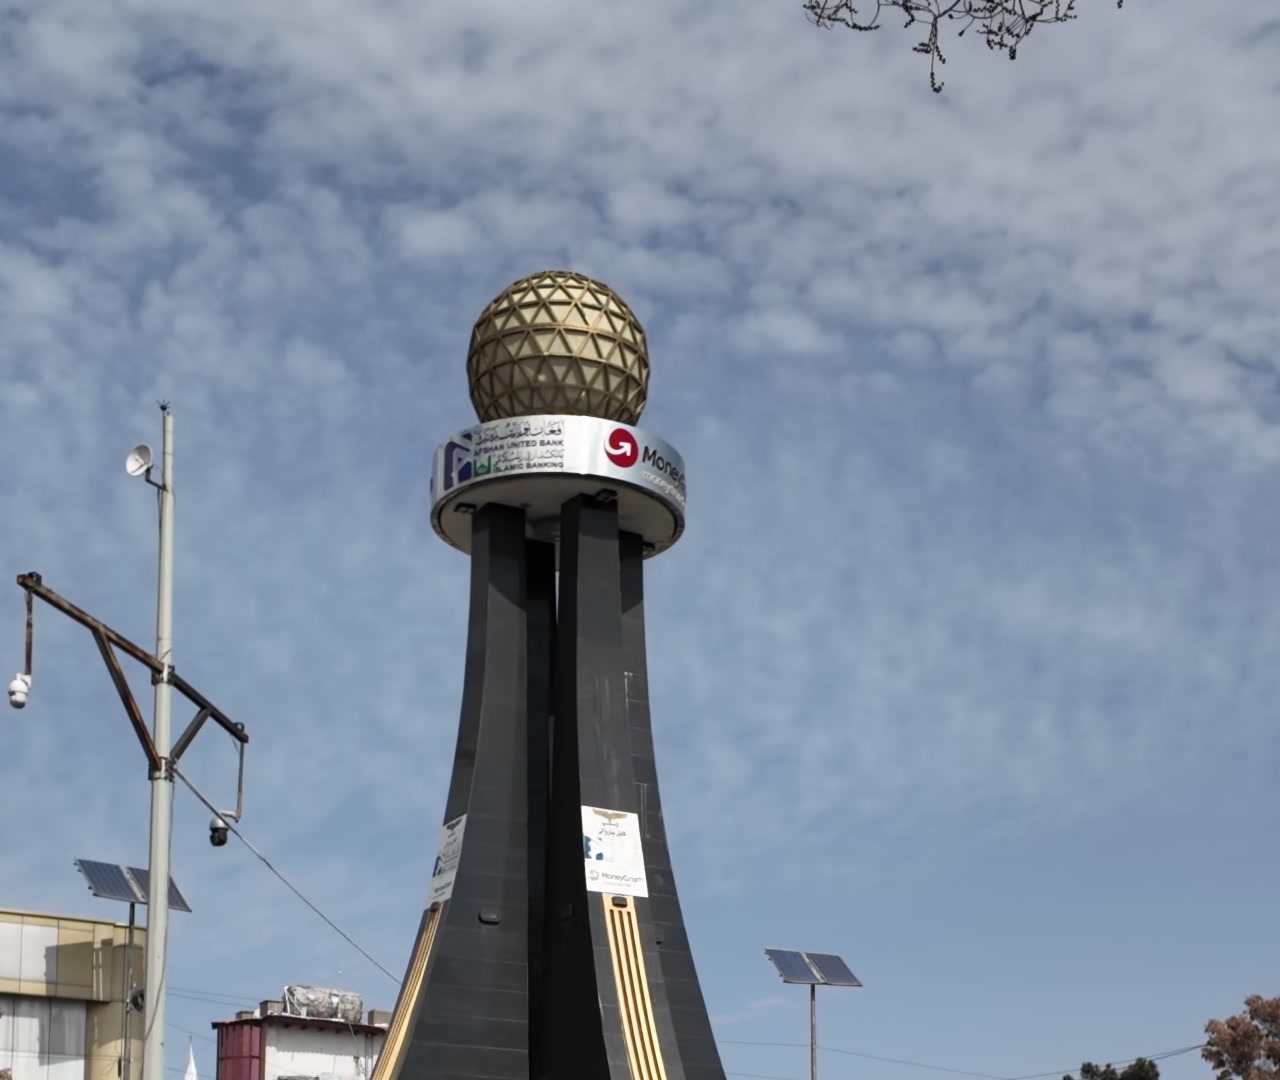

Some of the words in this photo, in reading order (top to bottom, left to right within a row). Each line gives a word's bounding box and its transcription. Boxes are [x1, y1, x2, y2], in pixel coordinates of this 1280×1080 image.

[474, 443, 505, 456] AFGHAN
[507, 439, 537, 449] UNITED
[540, 439, 564, 447] BANK
[493, 463, 524, 473] ISLAMIC
[526, 461, 564, 469] BANKING
[601, 871, 643, 883] MoneyGram
